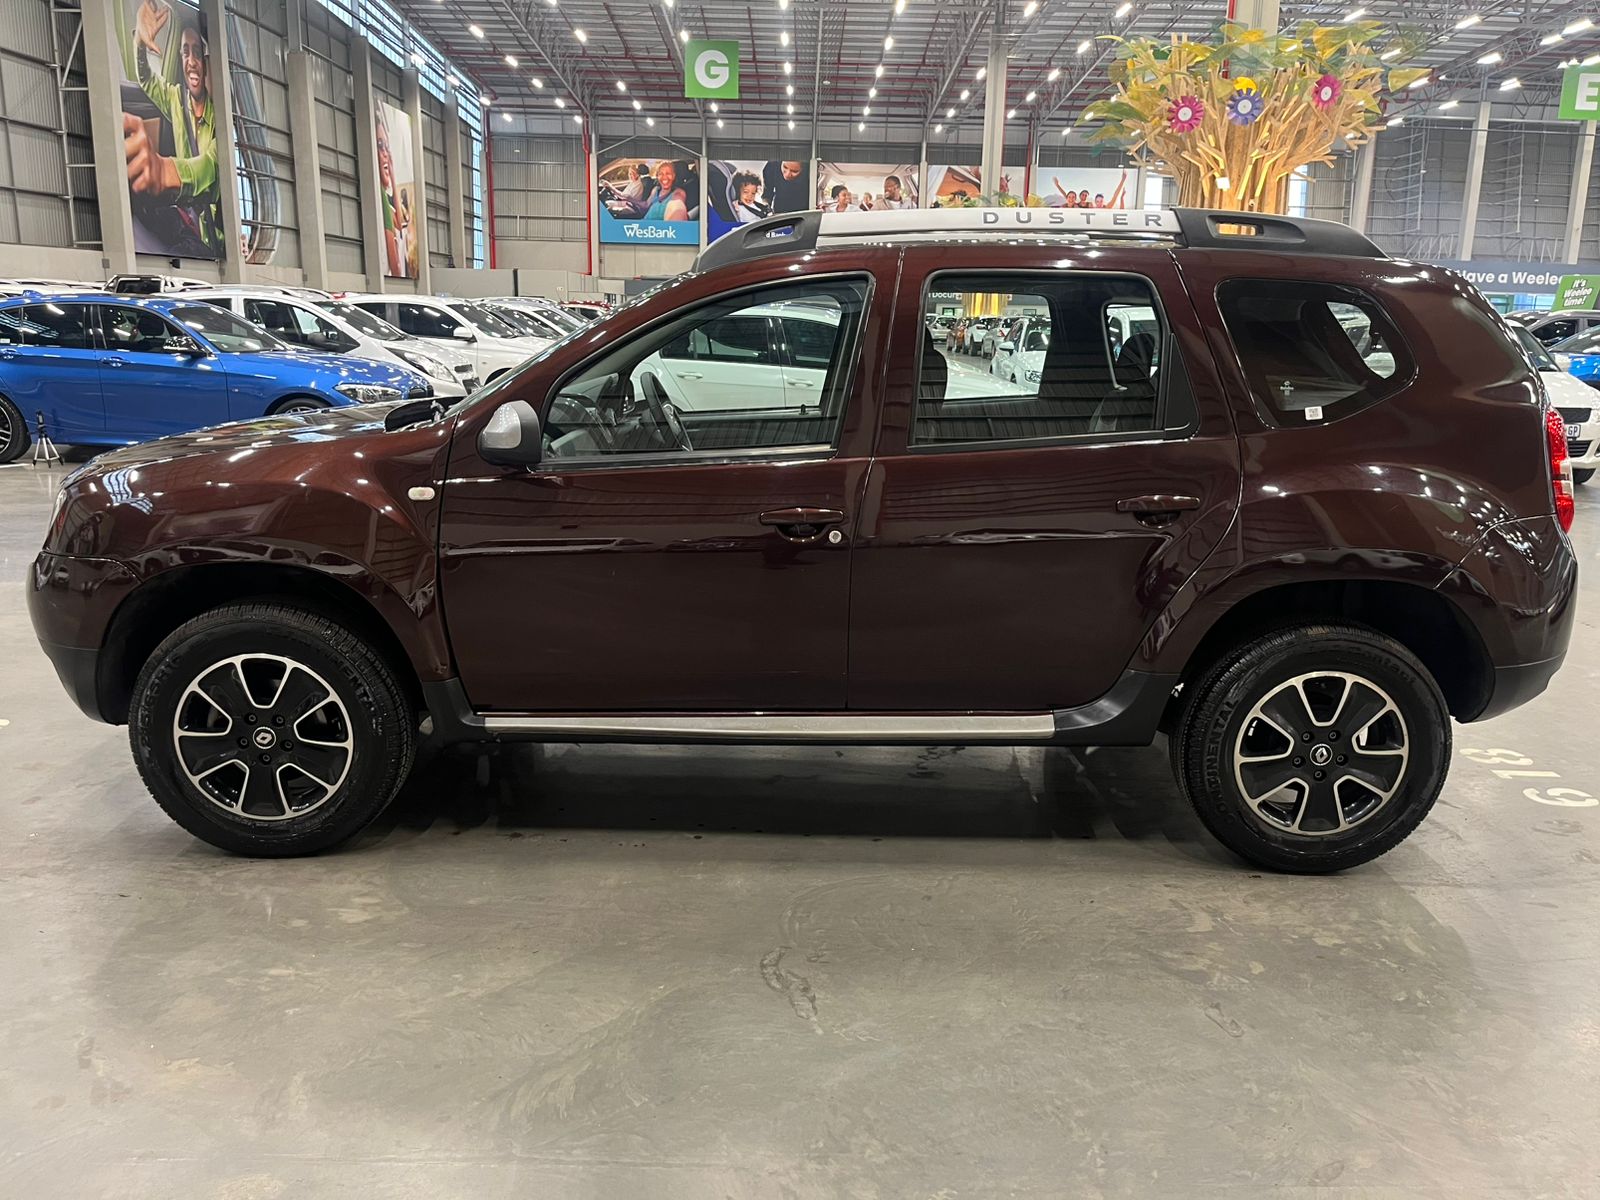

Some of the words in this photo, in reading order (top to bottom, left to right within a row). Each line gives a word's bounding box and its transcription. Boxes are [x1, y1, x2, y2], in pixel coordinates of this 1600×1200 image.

[694, 49, 730, 89] G
[1575, 73, 1600, 111] E
[983, 212, 1163, 227] DUSTER
[624, 223, 677, 239] WesBank
[1498, 273, 1508, 283] a
[1573, 279, 1587, 289] It's
[1564, 287, 1593, 299] Weelee
[1564, 296, 1587, 307] time!
[1568, 425, 1579, 437] GP
